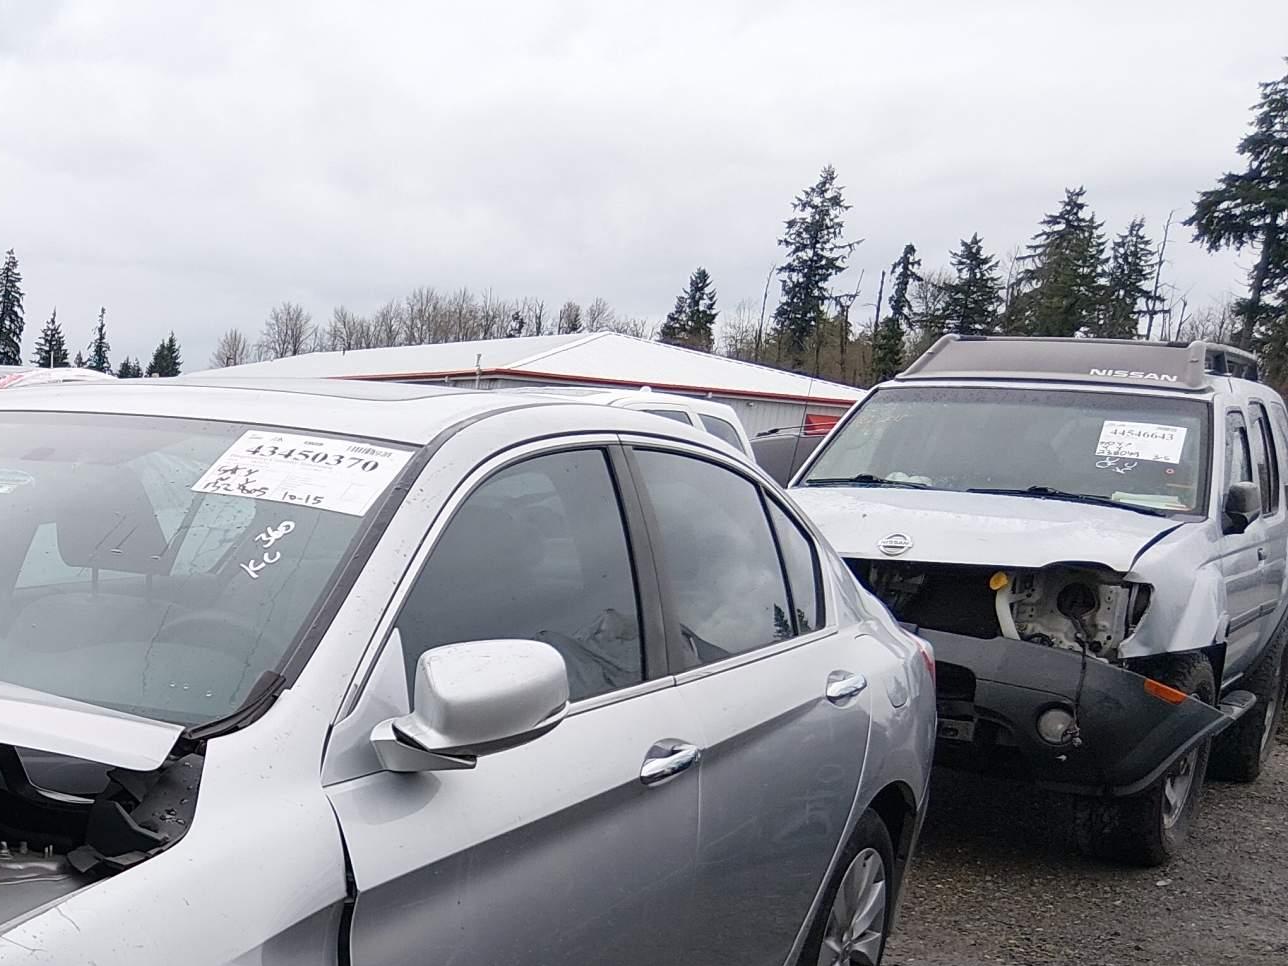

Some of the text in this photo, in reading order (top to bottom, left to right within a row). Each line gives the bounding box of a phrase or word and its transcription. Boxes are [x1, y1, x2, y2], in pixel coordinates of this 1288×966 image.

[1089, 368, 1178, 382] NISSAN
[246, 444, 379, 472] 43450370
[282, 491, 325, 505] 10-15
